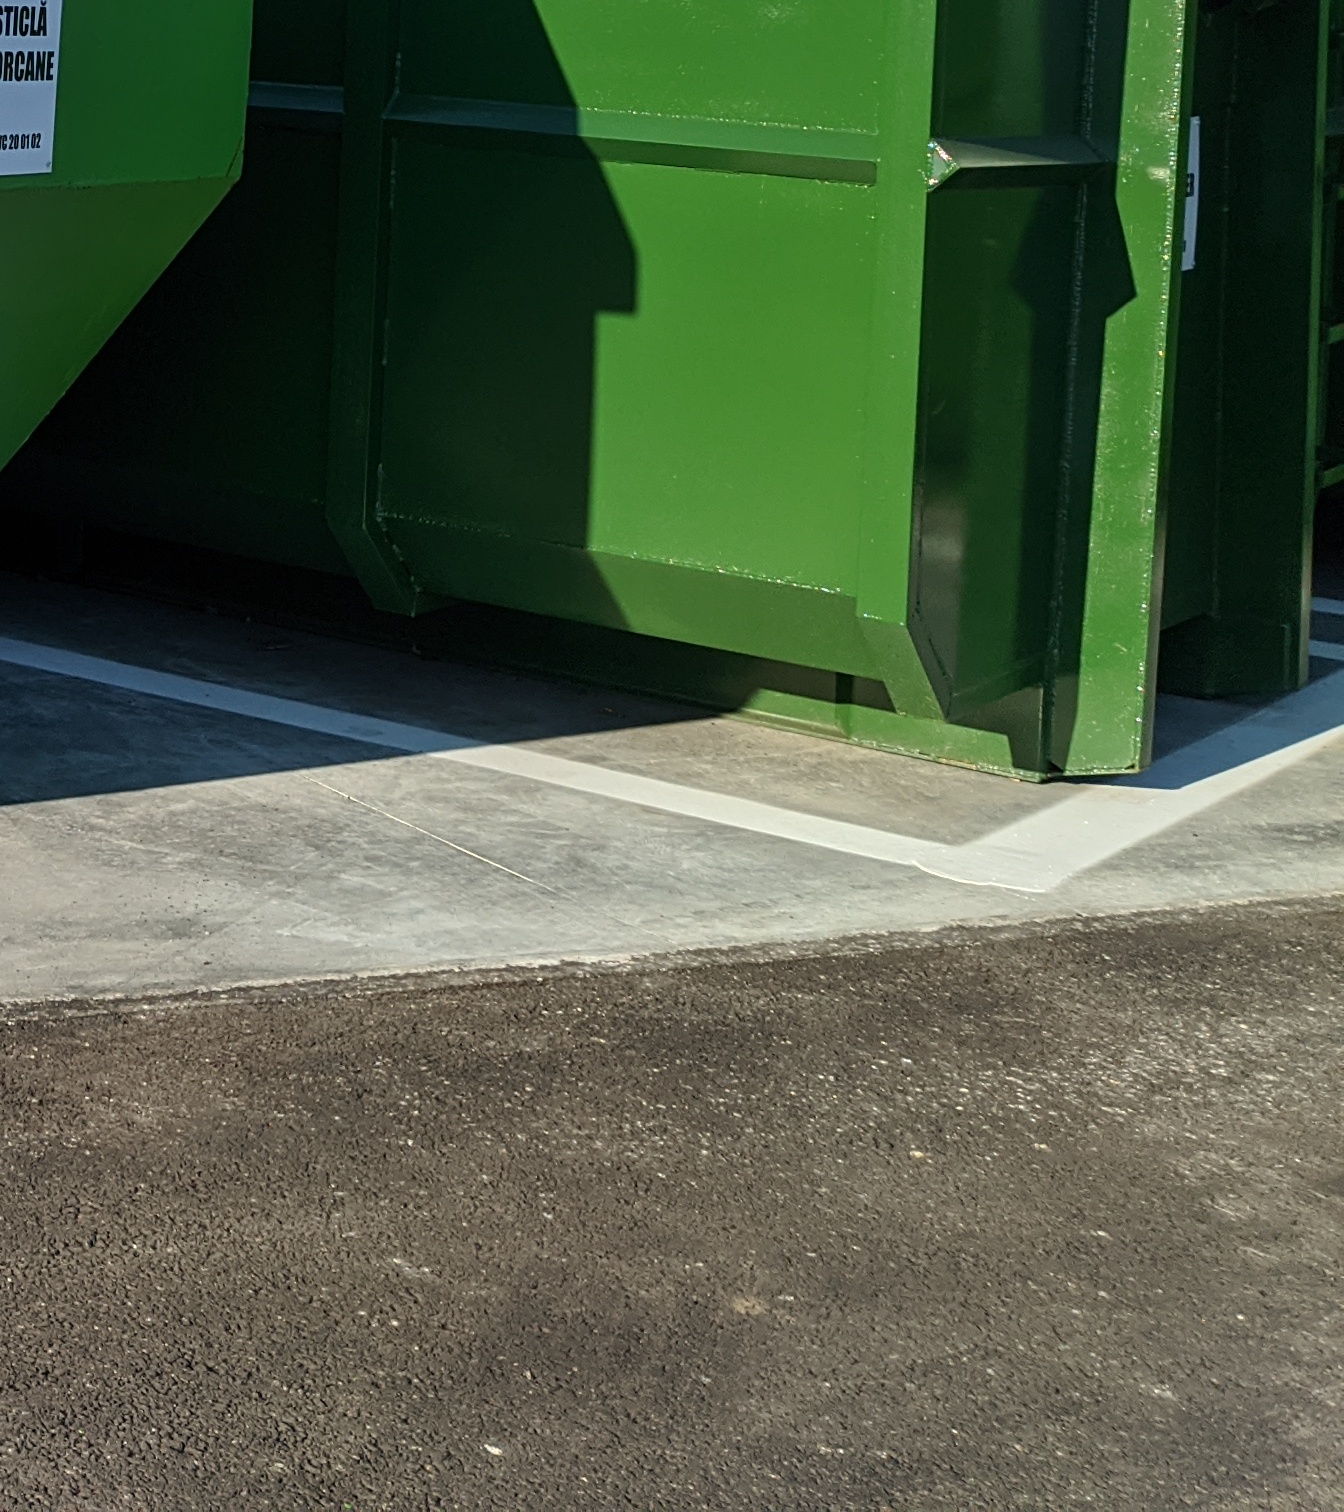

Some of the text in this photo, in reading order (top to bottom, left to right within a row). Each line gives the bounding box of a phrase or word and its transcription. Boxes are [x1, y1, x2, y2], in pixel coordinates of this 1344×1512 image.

[8, 134, 20, 150] 20
[20, 133, 30, 150] 01
[30, 132, 42, 149] 02
